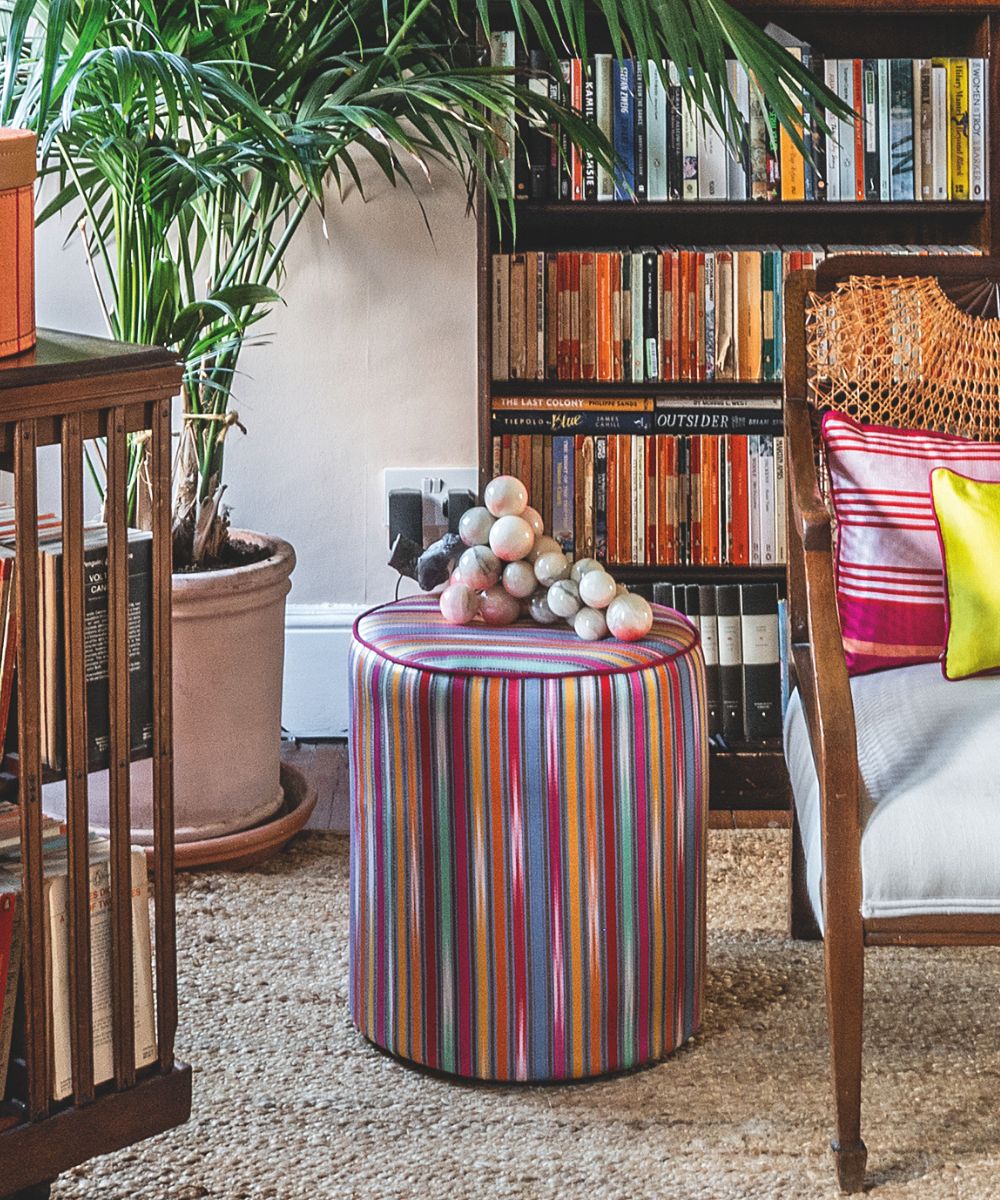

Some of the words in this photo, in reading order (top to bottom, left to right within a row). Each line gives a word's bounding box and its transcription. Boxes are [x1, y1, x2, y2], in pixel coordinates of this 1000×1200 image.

[620, 67, 629, 90] STEFAN
[955, 65, 963, 89] Hilary
[973, 68, 981, 105] WOMEN
[620, 91, 629, 114] ZWEIG
[973, 114, 981, 137] TROY
[502, 398, 518, 406] THE
[521, 399, 544, 407] LAST
[546, 399, 584, 408] COLONY
[551, 414, 583, 430] Blue
[657, 414, 729, 428] OUTSIDER
